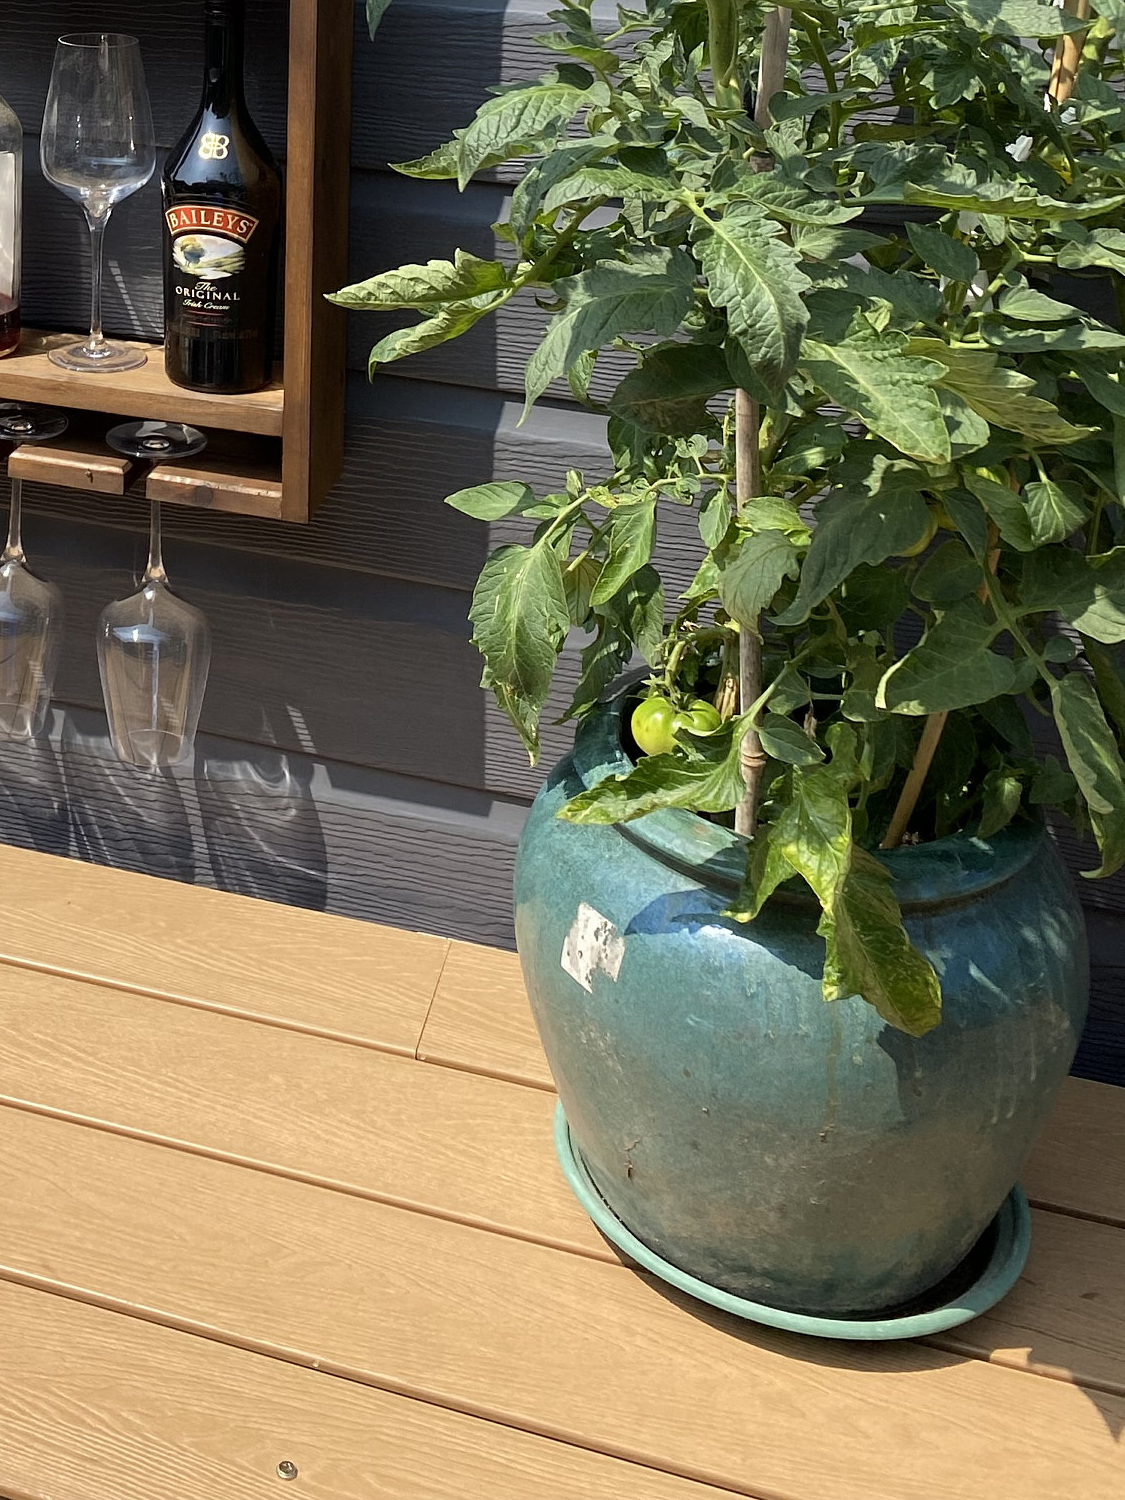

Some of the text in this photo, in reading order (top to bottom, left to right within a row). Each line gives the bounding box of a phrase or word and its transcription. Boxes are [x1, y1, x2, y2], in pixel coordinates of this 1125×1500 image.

[169, 209, 251, 233] BAILEYS
[175, 285, 241, 301] ORIGINAL
[195, 281, 218, 292] The
[182, 298, 231, 311] Irish Cream
